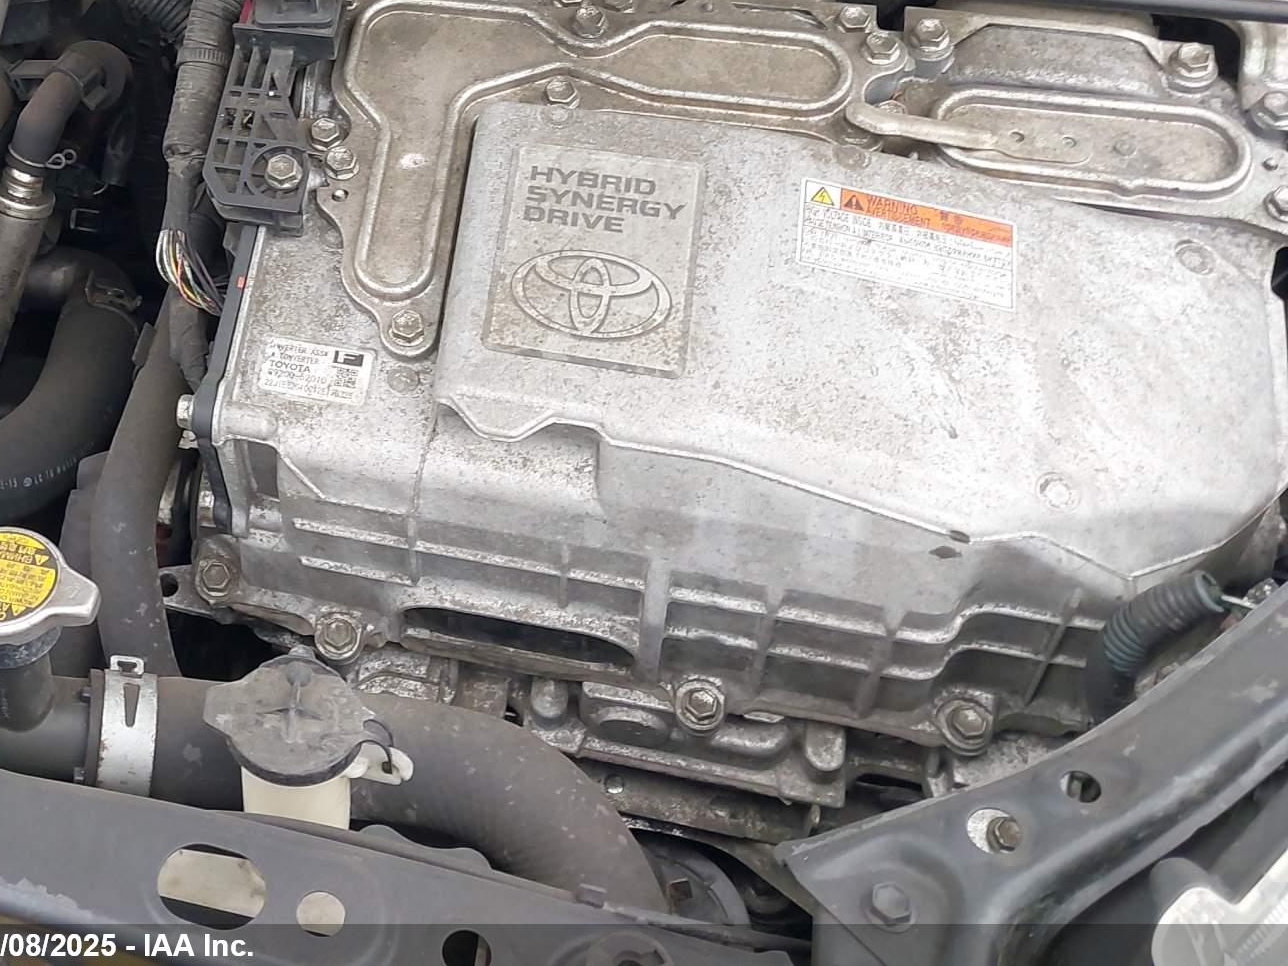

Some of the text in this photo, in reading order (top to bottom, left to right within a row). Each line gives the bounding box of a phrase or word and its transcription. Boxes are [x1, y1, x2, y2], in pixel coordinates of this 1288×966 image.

[530, 165, 657, 196] HYBRID
[526, 185, 688, 220] SYNERGY
[867, 195, 918, 216] WARNING
[523, 205, 625, 233] DRIVE
[269, 359, 310, 373] TOYOTA
